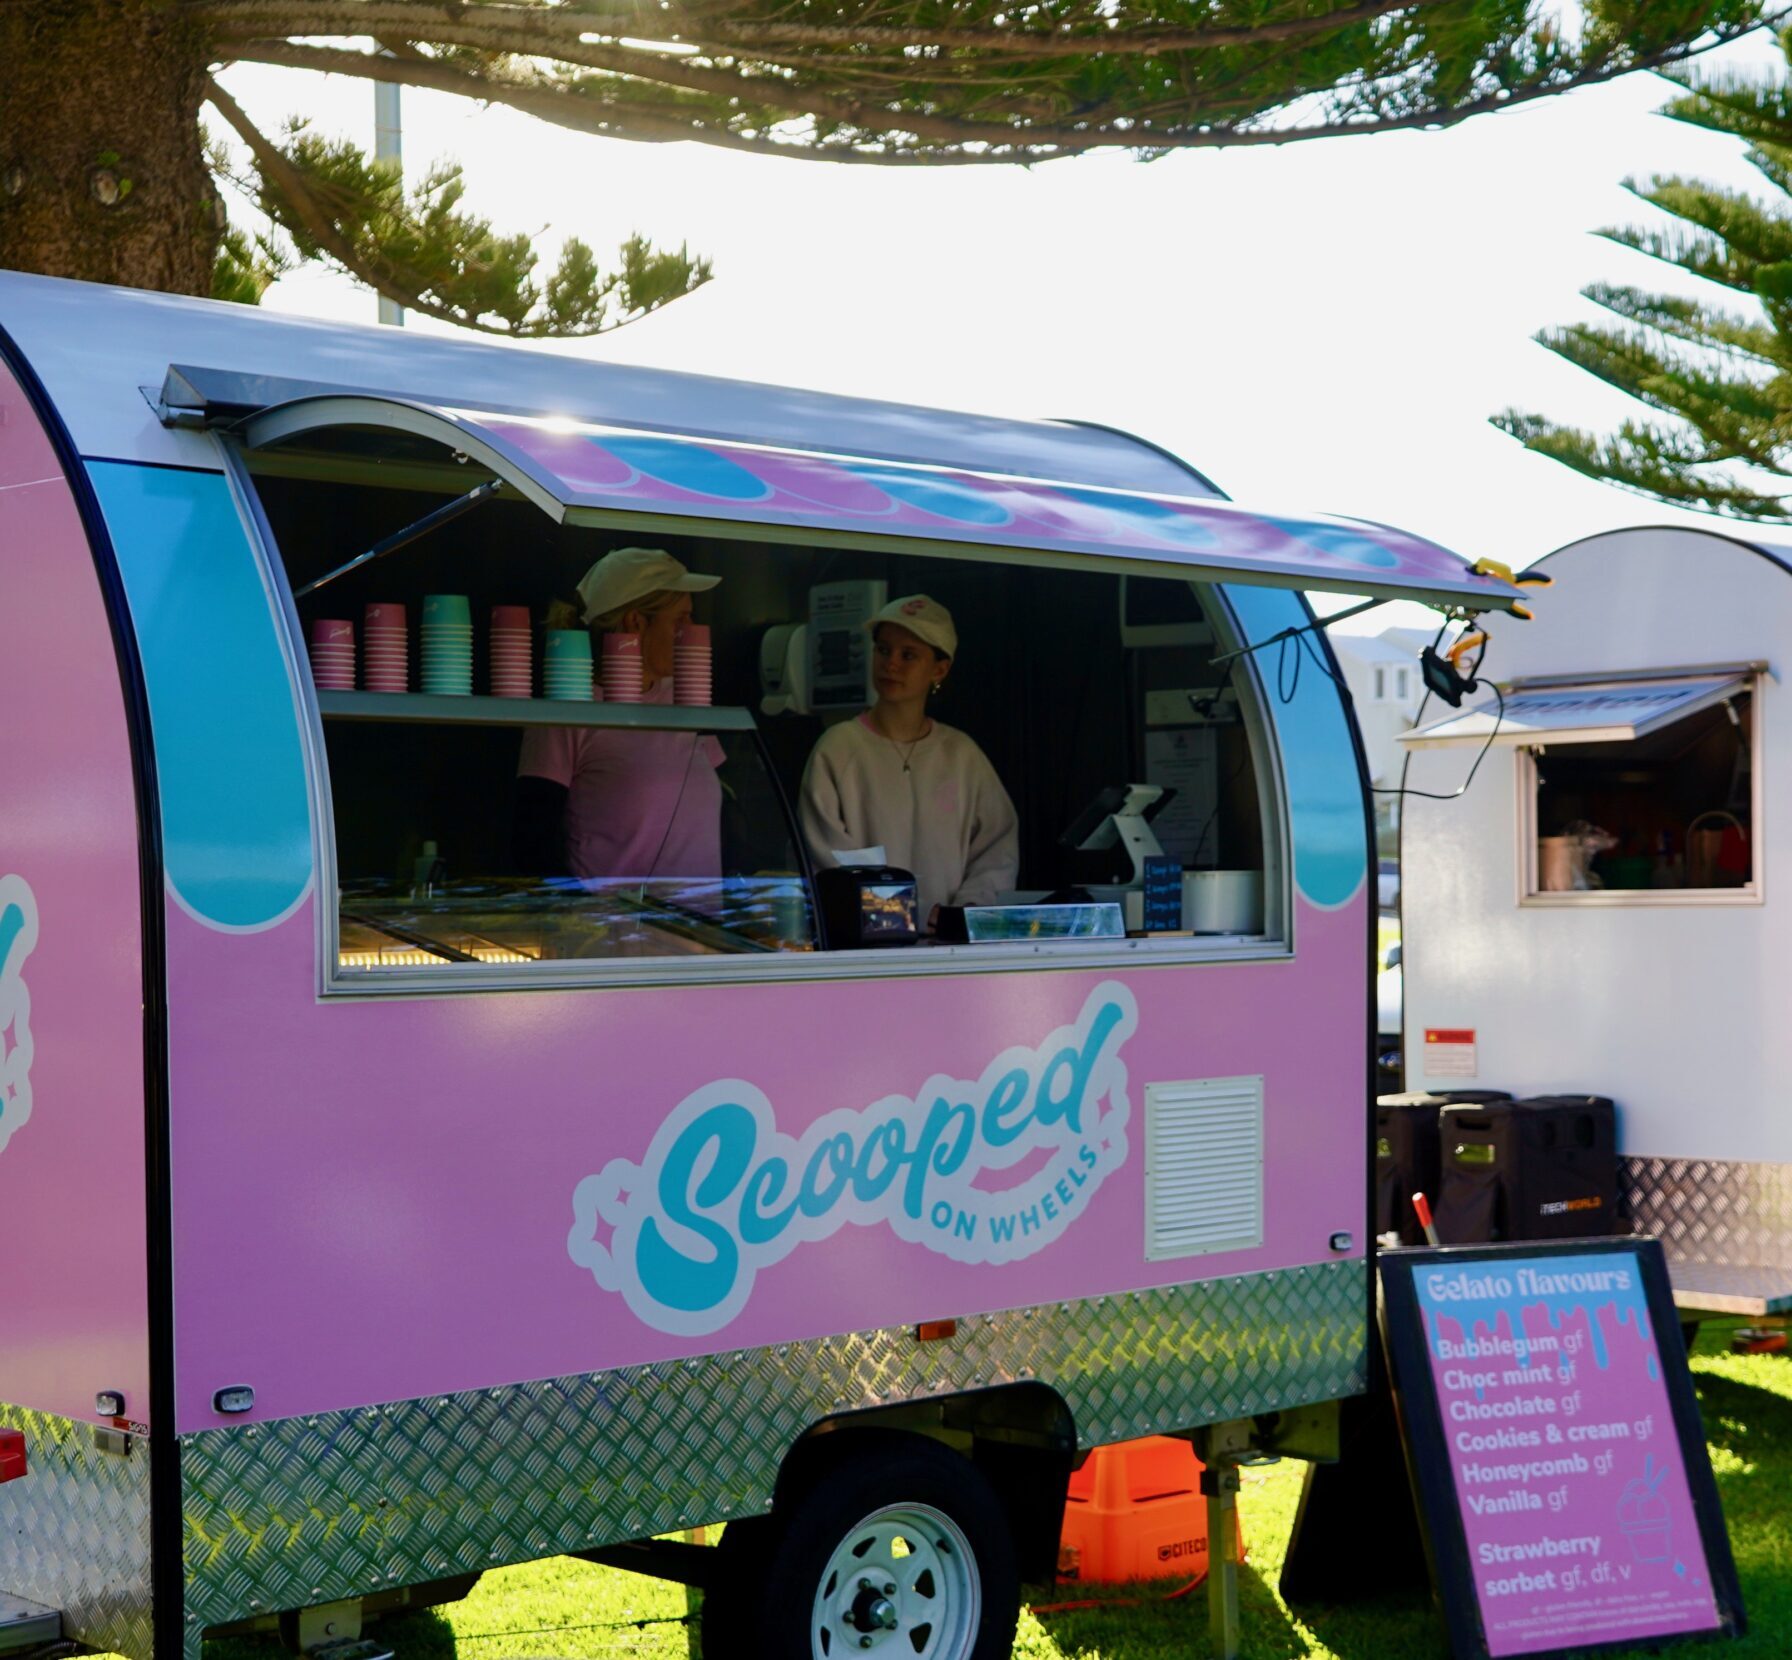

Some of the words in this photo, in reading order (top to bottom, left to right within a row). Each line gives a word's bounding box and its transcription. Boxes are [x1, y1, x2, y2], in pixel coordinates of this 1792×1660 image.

[636, 1001, 1123, 1311] Scooped
[931, 1200, 977, 1241] ON
[989, 1144, 1096, 1243] WHEELS
[1428, 1276, 1512, 1301] Gelato
[1517, 1269, 1630, 1296] flavours
[1438, 1334, 1559, 1359] Bubblegum
[1564, 1330, 1584, 1353] gf
[1444, 1370, 1497, 1389] Choc
[1503, 1364, 1552, 1384] mint
[1557, 1362, 1577, 1383] gf
[1450, 1396, 1556, 1420] Chocolate
[1561, 1392, 1581, 1415] gf
[1456, 1428, 1541, 1452] Cookies
[1546, 1424, 1562, 1443] &
[1568, 1422, 1629, 1441] cream
[1634, 1416, 1654, 1439] gf
[1462, 1454, 1589, 1484] Honeycomb
[1594, 1451, 1613, 1474] gf
[1468, 1491, 1542, 1515] Vanilla
[1547, 1487, 1568, 1509] gf
[1479, 1536, 1601, 1564] Strawberry
[1485, 1573, 1556, 1596] sorbet
[1560, 1568, 1587, 1591] gf,
[1591, 1564, 1616, 1584] df,
[1619, 1567, 1632, 1580] v
